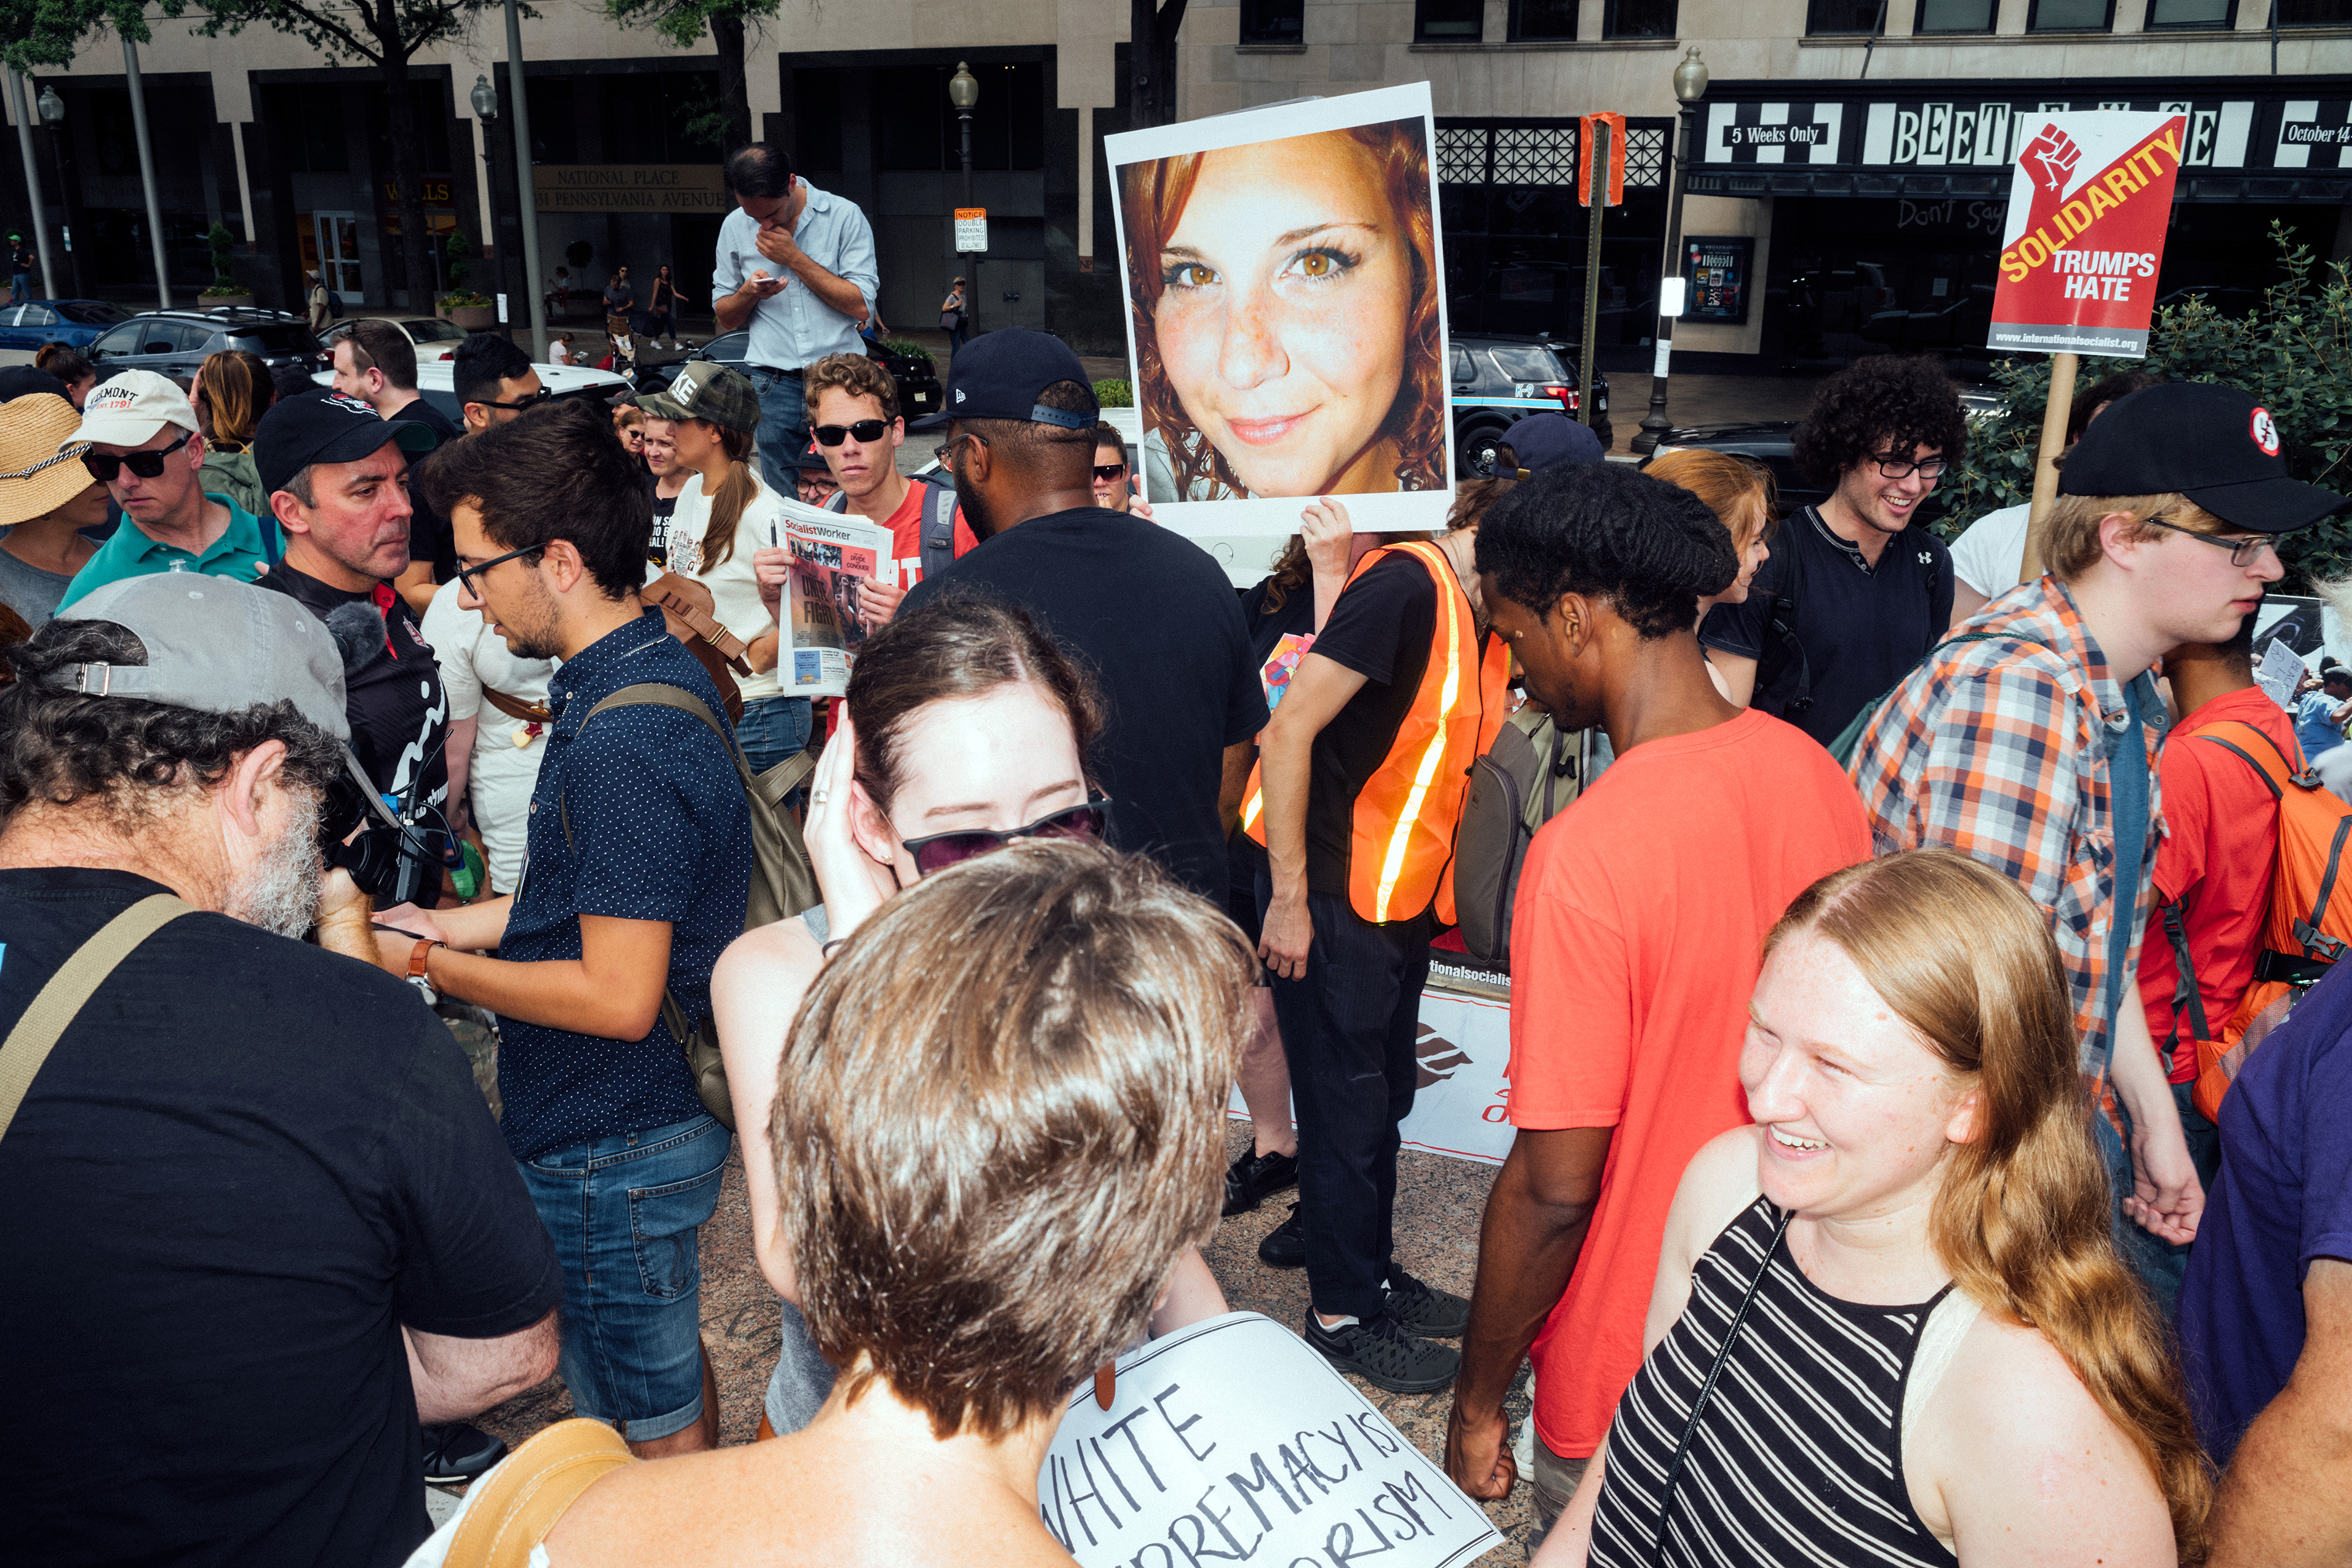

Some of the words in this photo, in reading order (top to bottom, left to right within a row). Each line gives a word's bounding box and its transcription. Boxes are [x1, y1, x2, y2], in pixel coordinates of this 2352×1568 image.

[1732, 128, 1742, 144] 5
[1747, 127, 1786, 143] Weeks
[1790, 125, 1820, 145] Only
[2288, 125, 2335, 142] October
[558, 170, 627, 185] NATIONAL
[634, 170, 681, 185] PLACE
[556, 193, 656, 207] PENNSYLVANIA
[662, 193, 725, 207] AVENUE
[1999, 128, 2181, 283] SOLIDARITY
[1897, 199, 1957, 229] Don't
[1967, 200, 2007, 235] Say
[1079, 260, 1092, 269] NP
[2053, 250, 2155, 277] TRUMPS
[2063, 275, 2132, 302] HATE
[1995, 332, 2138, 351] www.internationalsocialist.org
[91, 387, 139, 405] VERMONT
[1515, 383, 1534, 398] K-9
[109, 400, 132, 408] 1791
[846, 562, 870, 572] CONQUER
[850, 555, 866, 563] DIVIDE
[802, 575, 829, 603] UNITE
[804, 601, 835, 627] FIGHT
[1345, 1412, 1400, 1459] IS
